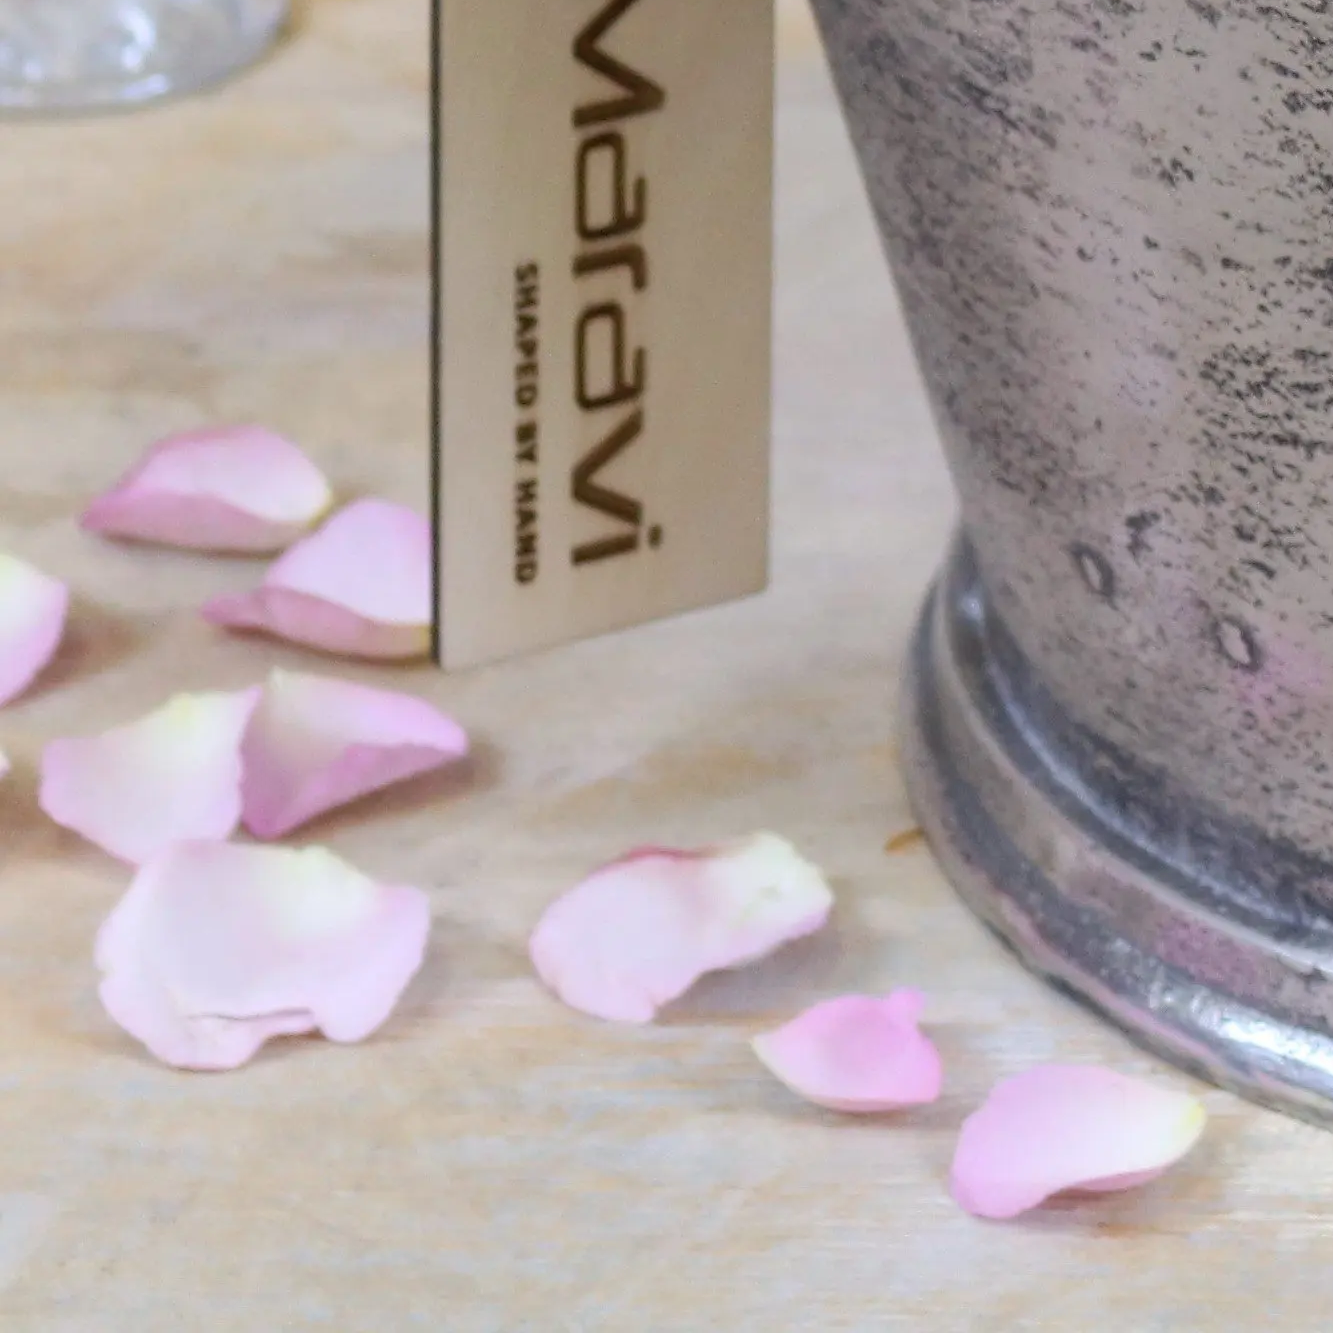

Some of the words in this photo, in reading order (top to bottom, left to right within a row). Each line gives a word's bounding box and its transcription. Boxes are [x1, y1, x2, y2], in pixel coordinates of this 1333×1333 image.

[513, 260, 540, 410] SHAPED
[513, 418, 540, 464] BY
[513, 477, 540, 586] HAND
